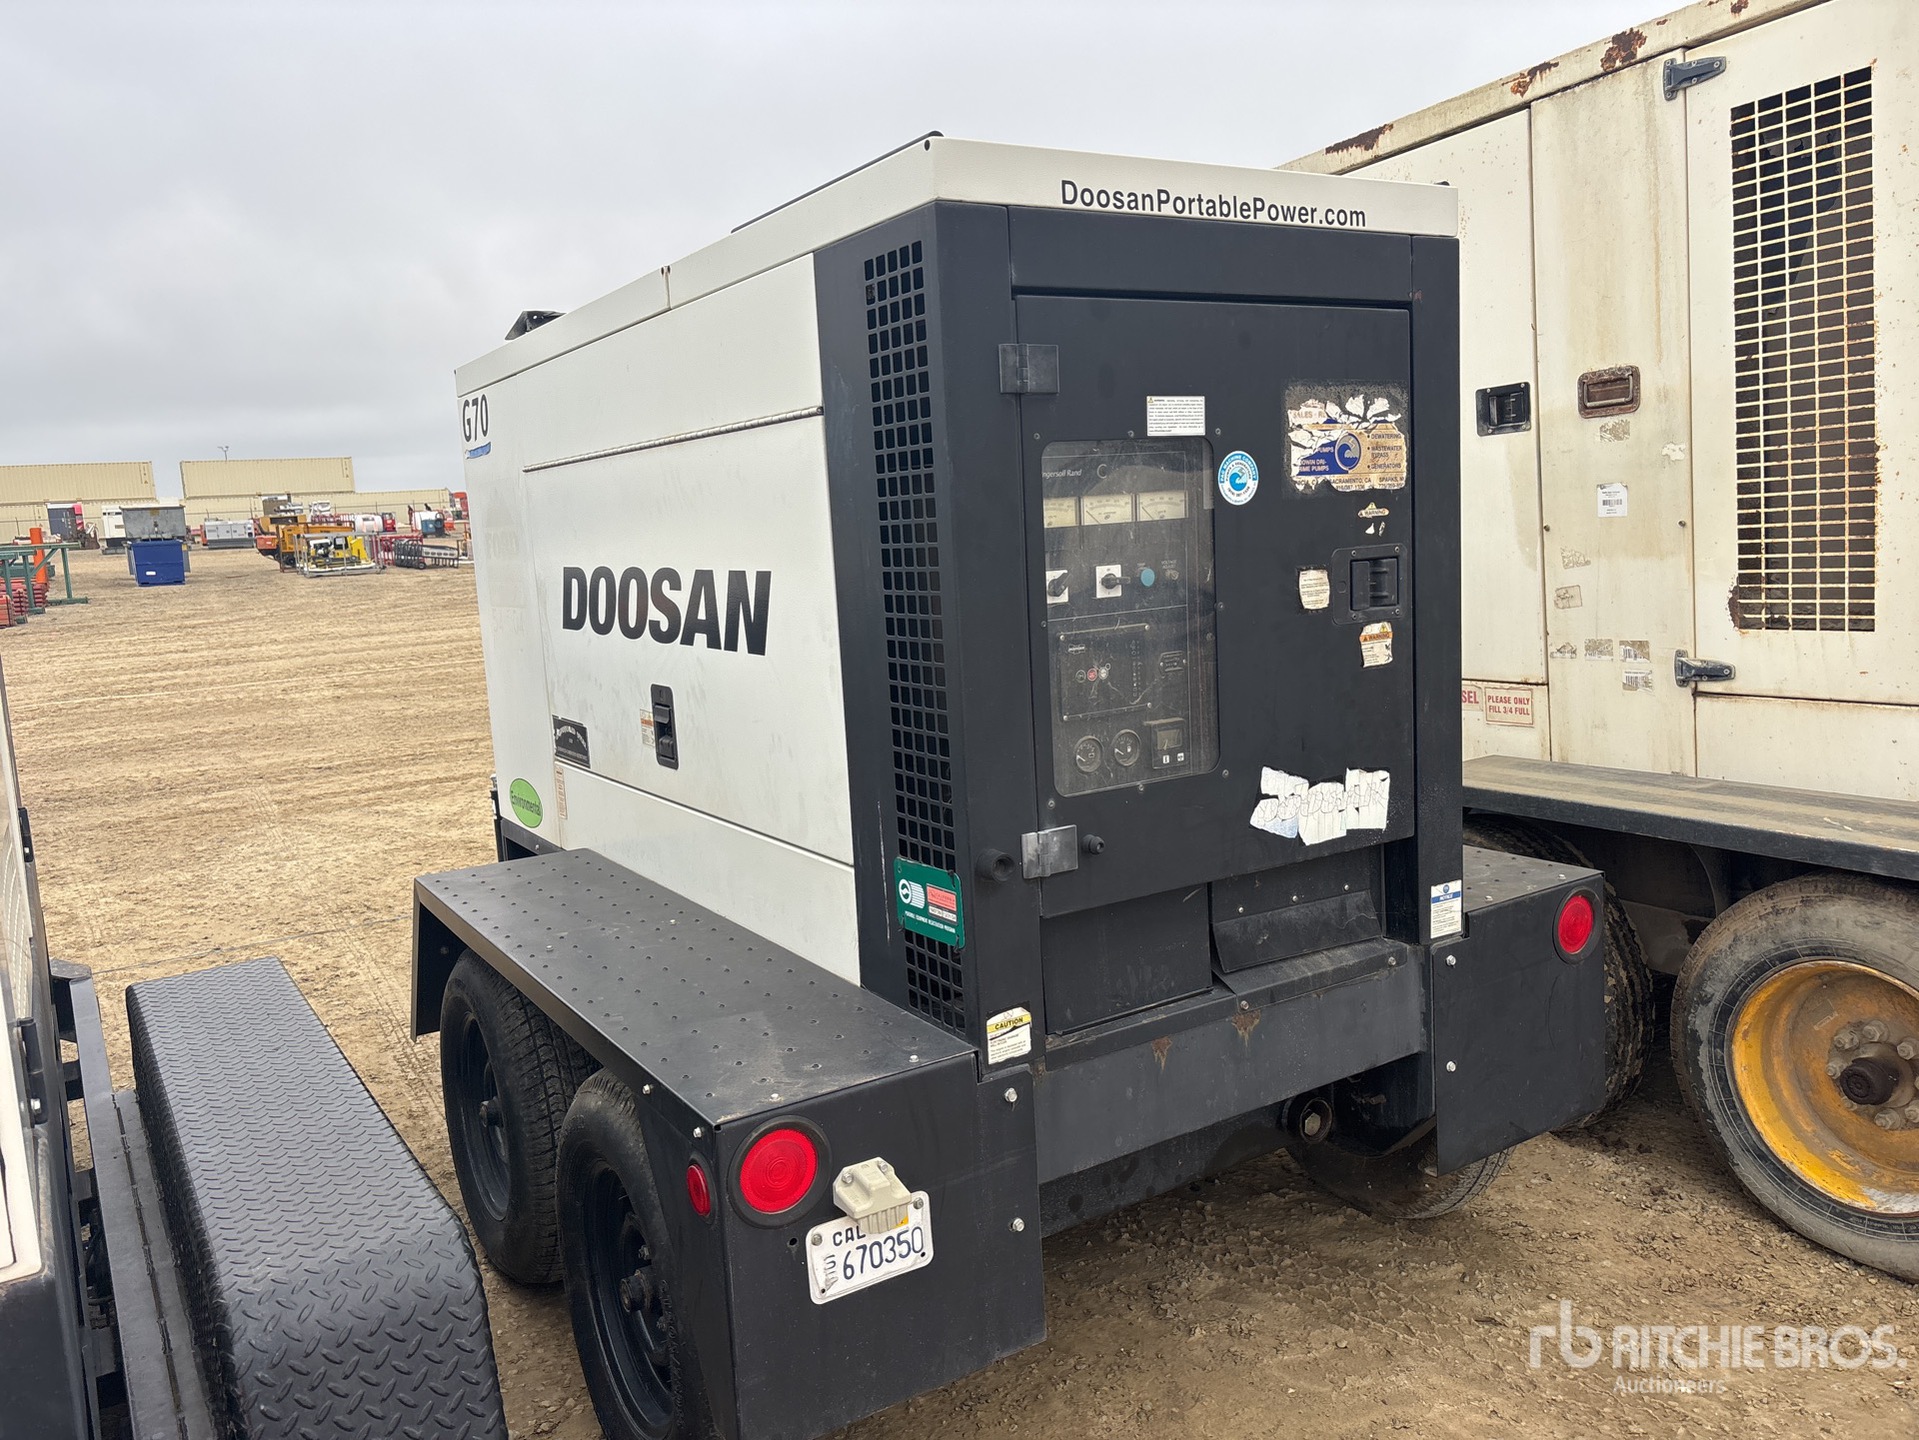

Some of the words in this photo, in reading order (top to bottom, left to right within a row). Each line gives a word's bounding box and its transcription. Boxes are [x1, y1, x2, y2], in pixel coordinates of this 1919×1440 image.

[1061, 180, 1366, 227] DoosanPortablePower.com
[463, 394, 489, 443] G70
[563, 566, 772, 656] DOOSAN
[1369, 632, 1389, 640] WARNING
[1462, 690, 1480, 704] SEL
[1488, 695, 1512, 705] PLEASE
[1513, 696, 1530, 705] ONLY
[1489, 705, 1502, 714] FILL
[1503, 706, 1513, 714] 3/4
[1514, 707, 1530, 716] FULL
[995, 1017, 1023, 1030] CAUTION
[833, 1226, 866, 1247] CAL
[843, 1226, 924, 1280] 670350
